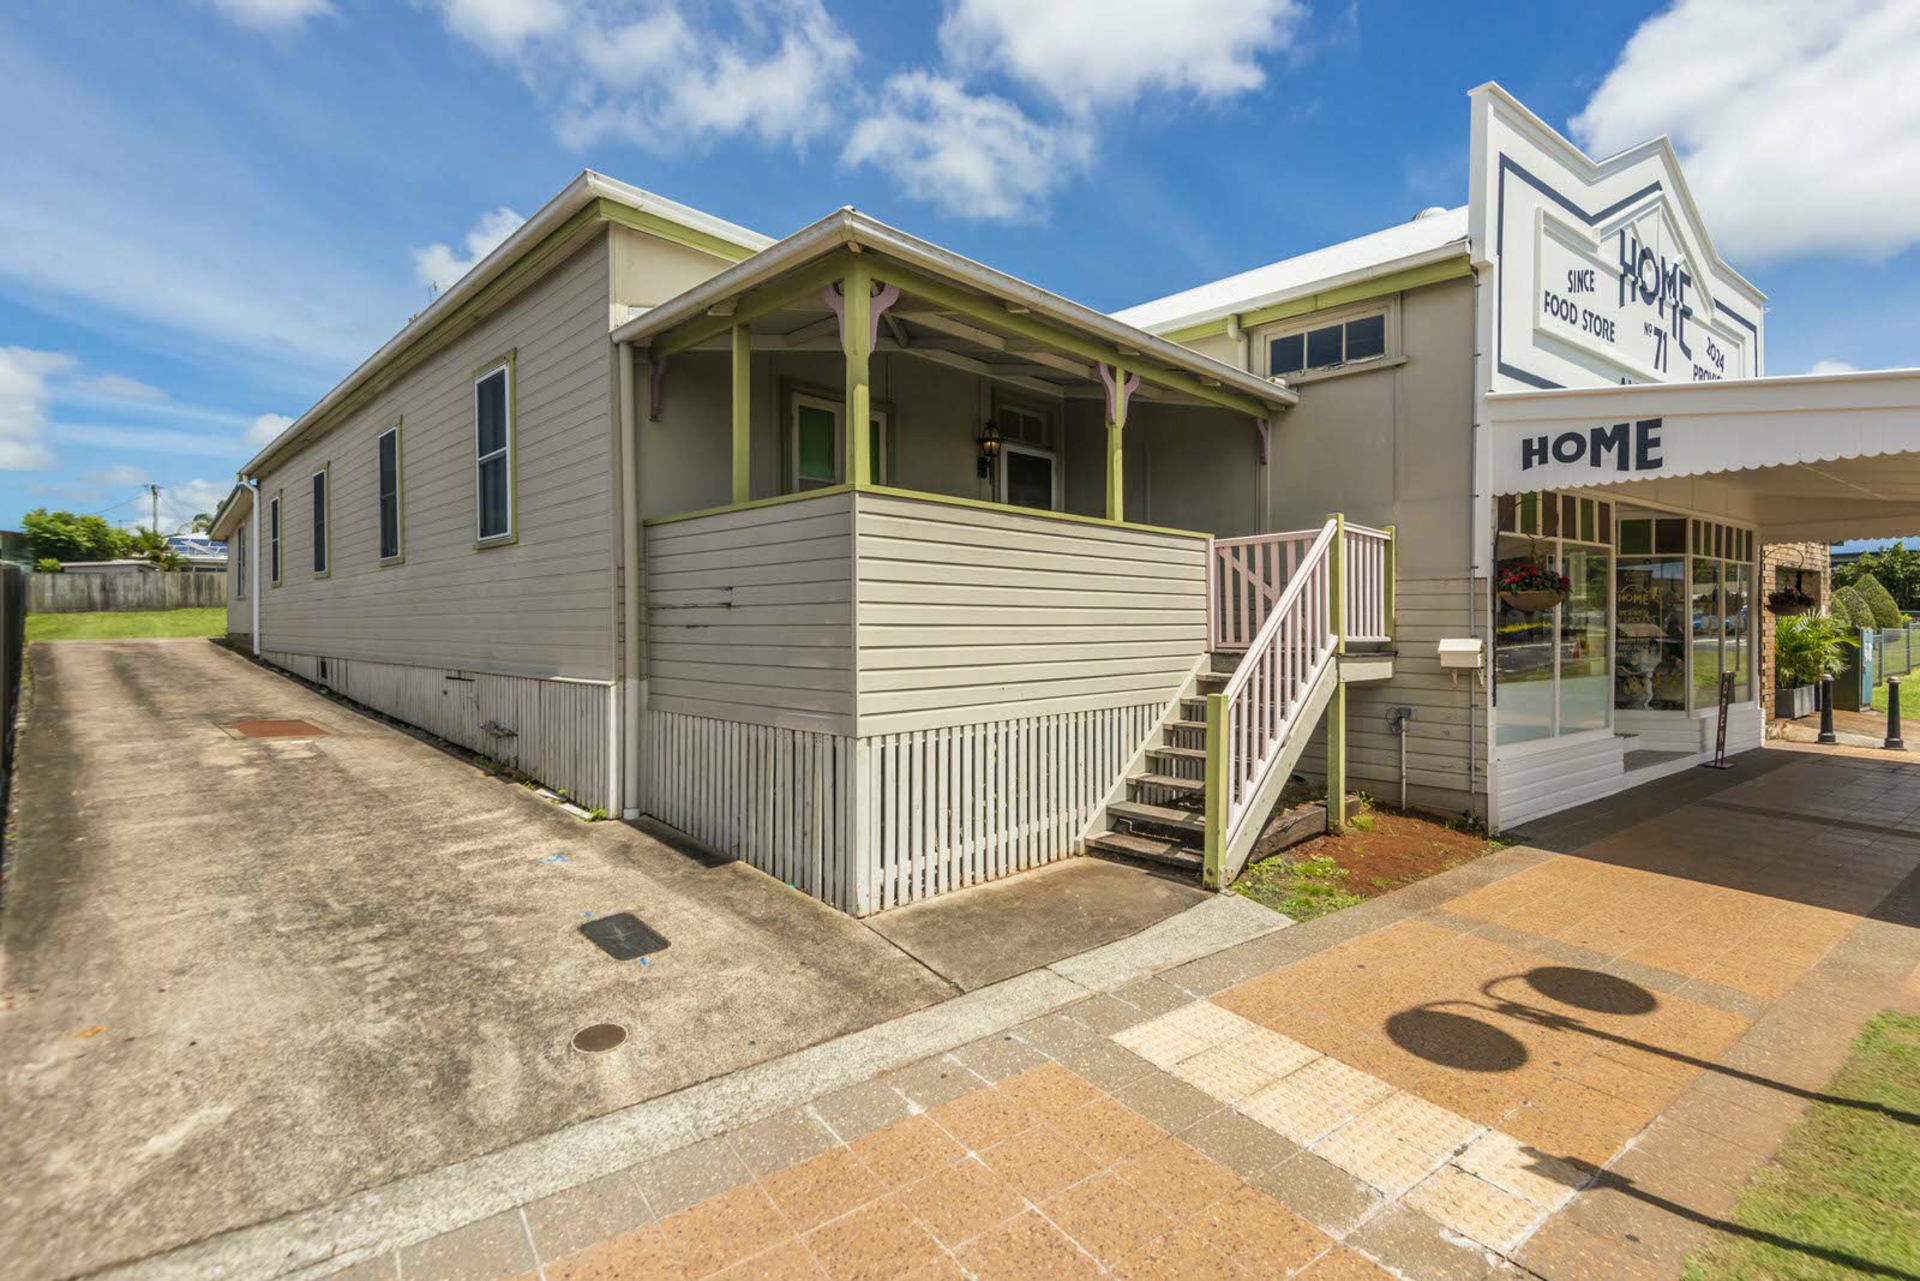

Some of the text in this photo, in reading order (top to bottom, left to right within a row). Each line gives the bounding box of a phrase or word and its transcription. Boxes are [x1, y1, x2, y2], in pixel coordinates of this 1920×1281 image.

[1567, 269, 1595, 293] SINCE
[1619, 228, 1692, 361] HOME
[1543, 291, 1615, 343] FOOD STORE
[1654, 326, 1668, 374] 71
[1706, 336, 1725, 373] 2024
[1521, 417, 1663, 472] HOME
[1618, 593, 1649, 606] HOME
